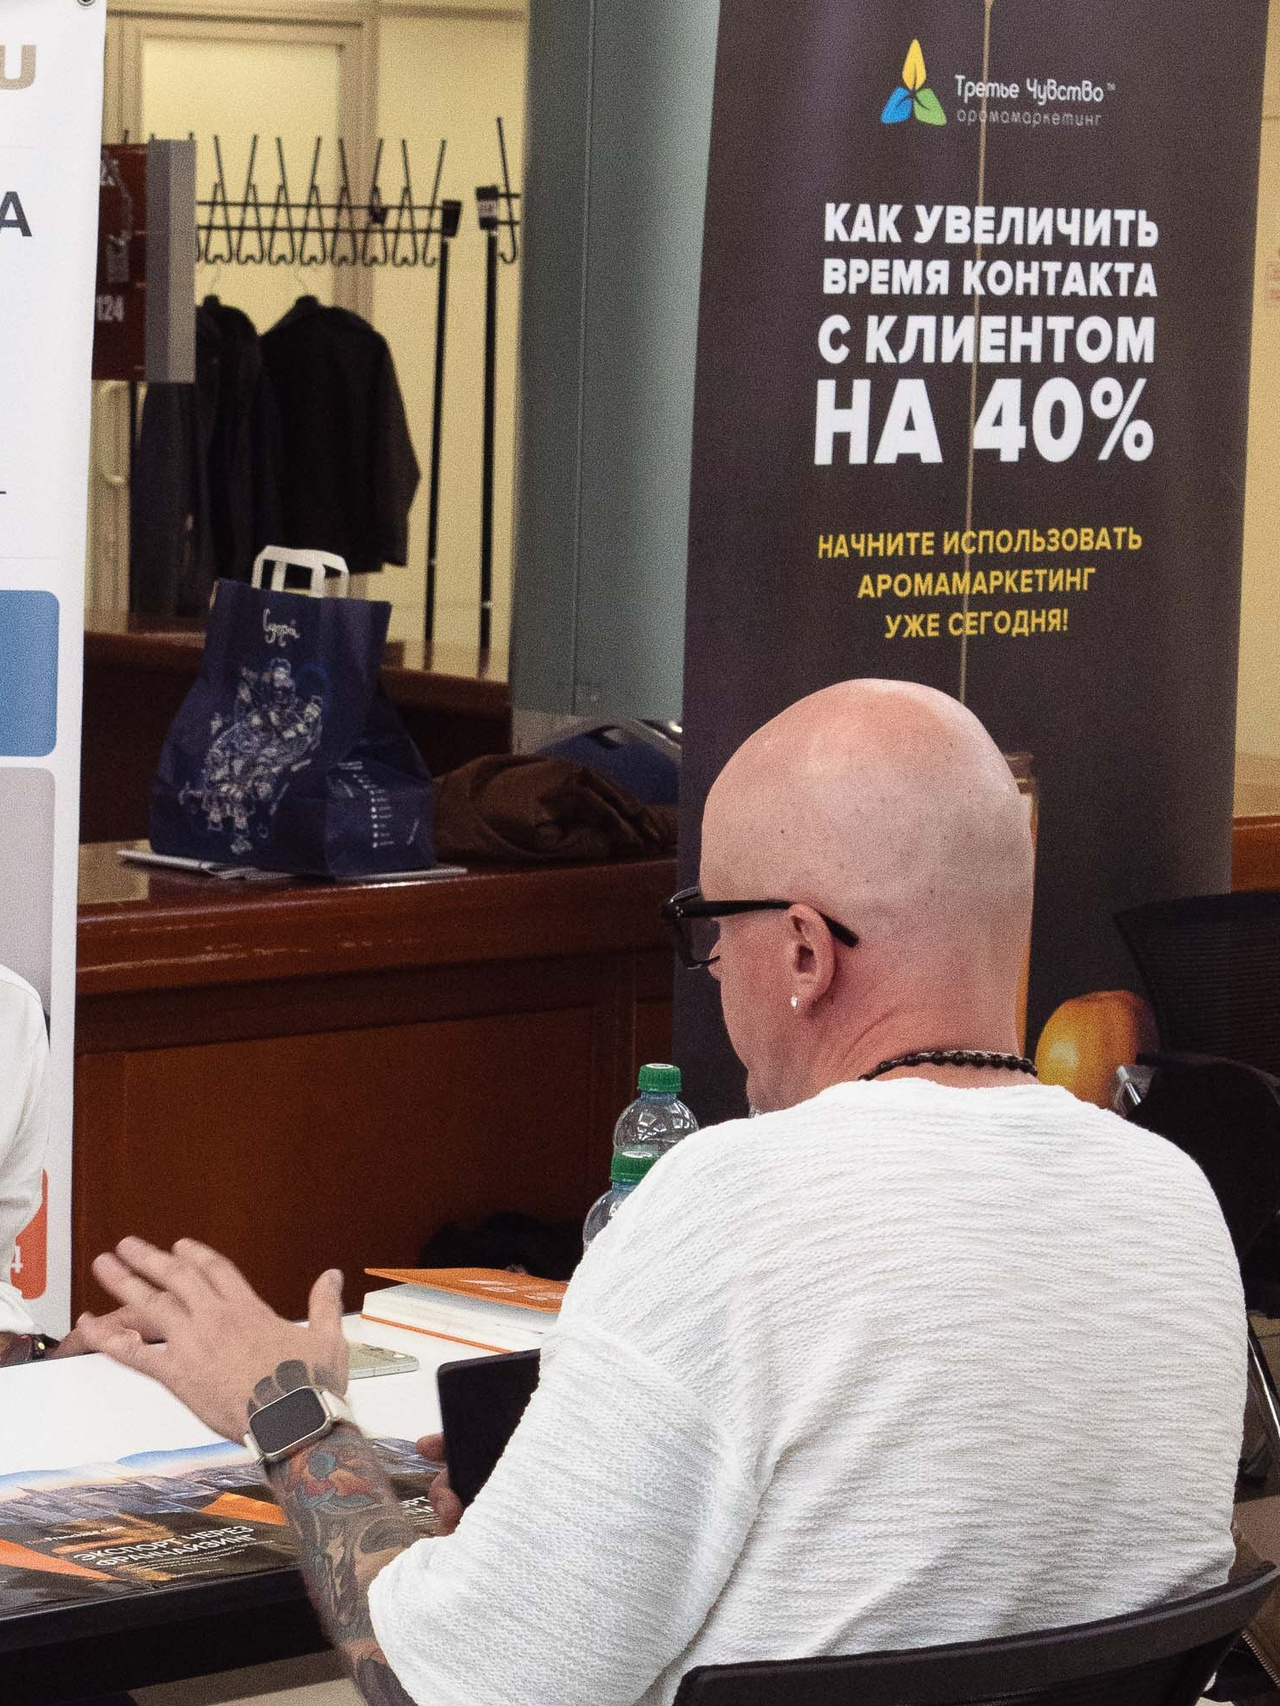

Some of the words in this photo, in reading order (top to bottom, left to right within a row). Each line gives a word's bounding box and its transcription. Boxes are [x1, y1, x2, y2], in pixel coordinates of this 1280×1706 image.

[955, 75, 1019, 103] Третье
[823, 203, 903, 243] КАК
[914, 205, 1159, 247] УВЕЛИЧИТЬ
[823, 258, 950, 295] ВРЕМЯ
[963, 260, 1158, 297] КОНТАКТА
[818, 314, 851, 364] С
[865, 315, 1155, 363] КЛИЕНТОМ
[814, 378, 943, 465] НА
[973, 377, 1154, 462] 40%
[818, 532, 935, 559] НАЧНИТЕ
[943, 527, 1142, 555] ИСПОЛЬЗОВАТЬ
[857, 567, 1096, 599] АРОМАМАРКЕТИНГ
[884, 613, 940, 639] УЖЕ
[948, 608, 1068, 638] СЕГОДНЯ!
[73, 1537, 185, 1562] ЭКСПОРТ
[181, 1525, 255, 1541] ЧЕРЕЗ
[96, 1534, 258, 1567] ФРАНЧАЙЗИНГ
